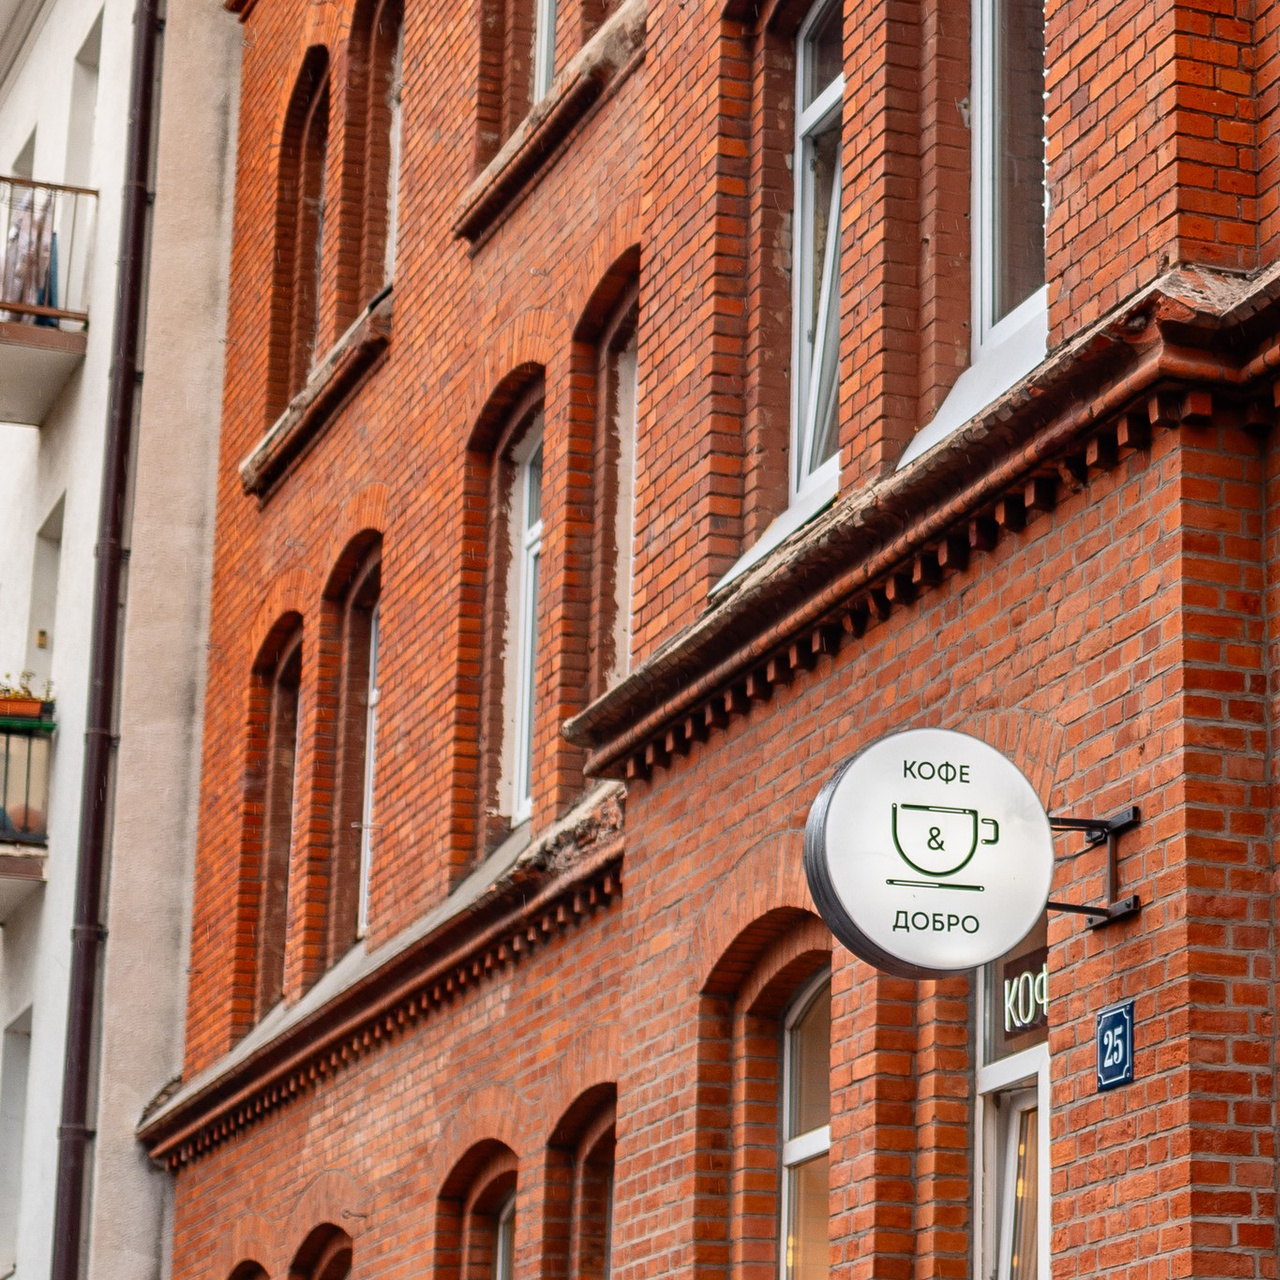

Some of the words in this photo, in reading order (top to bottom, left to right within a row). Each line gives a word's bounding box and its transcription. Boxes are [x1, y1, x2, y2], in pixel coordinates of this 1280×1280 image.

[903, 760, 970, 784] КОФЕ
[927, 826, 945, 852] &
[892, 910, 980, 934] ДОБРО
[1103, 1025, 1124, 1068] 25
